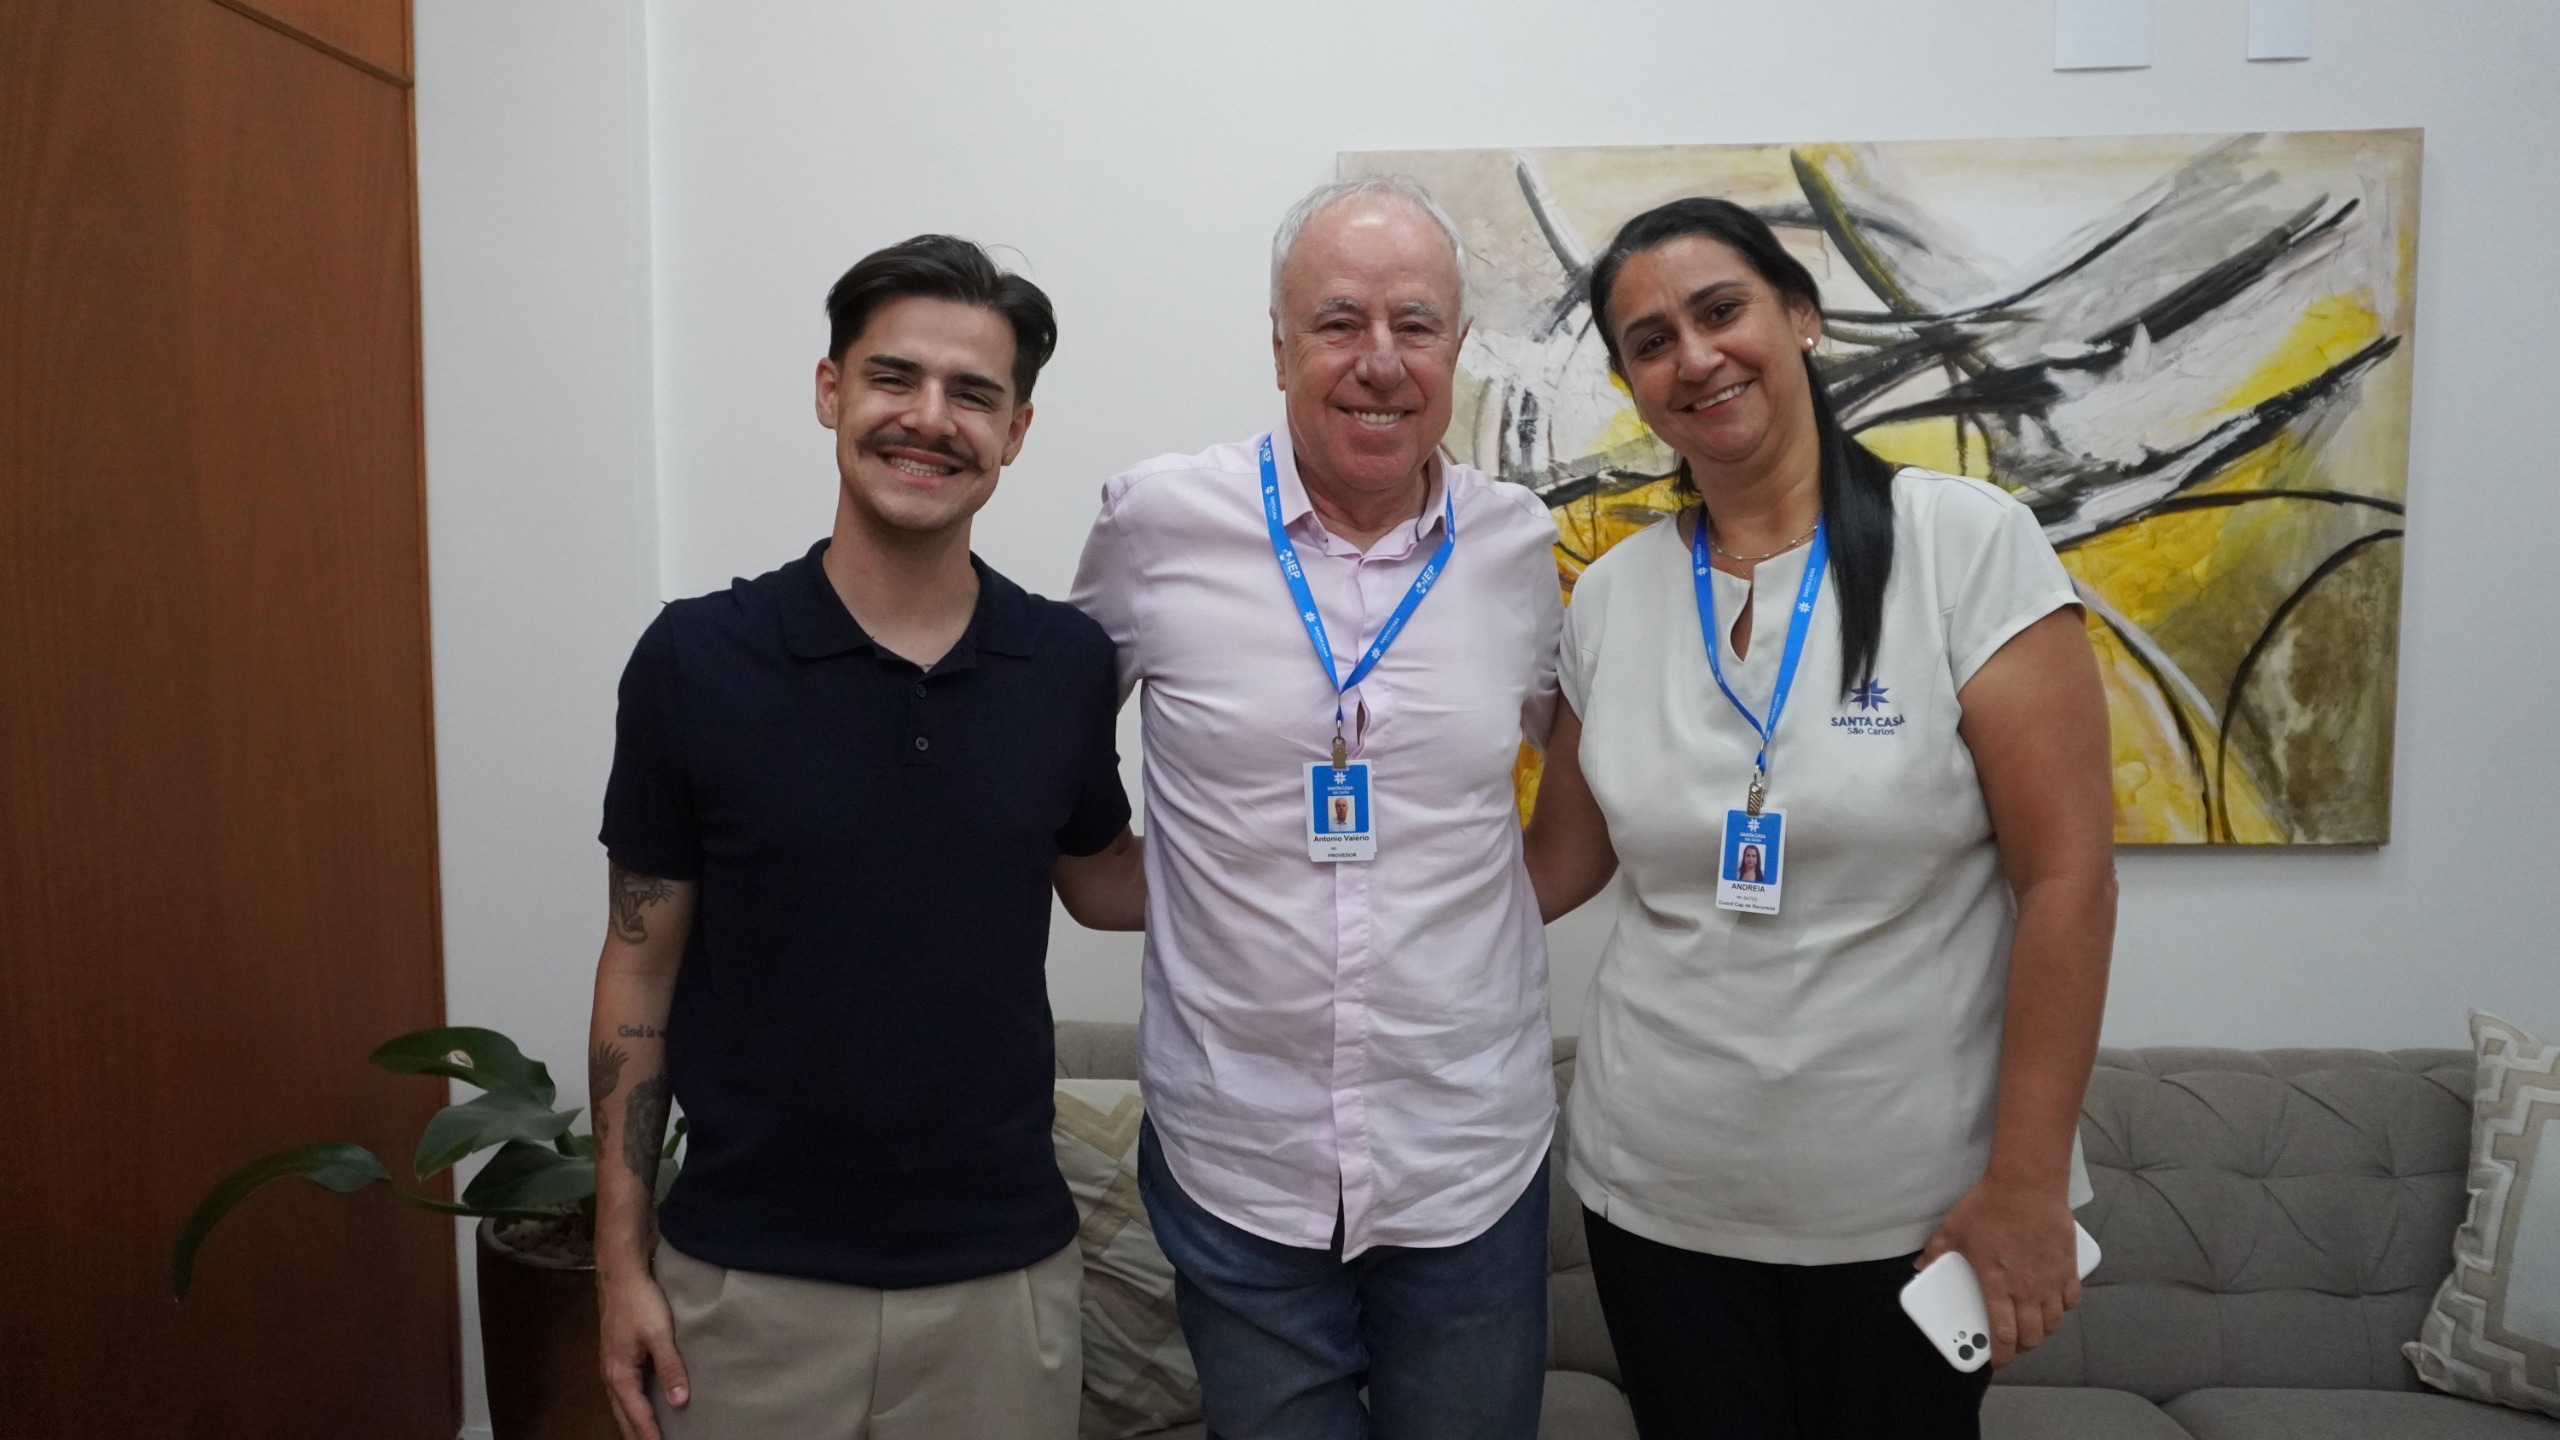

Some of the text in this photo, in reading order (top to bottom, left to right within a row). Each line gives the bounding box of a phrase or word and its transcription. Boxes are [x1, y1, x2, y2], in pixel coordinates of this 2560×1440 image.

[1286, 560, 1301, 580] IEP
[1423, 564, 1435, 584] IEP
[1380, 617, 1400, 645] SANTA CASA
[1831, 713, 1906, 727] SANTA CASA
[1847, 727, 1895, 736] São Carlos
[1731, 883, 1765, 892] ANDREIA
[618, 1024, 644, 1038] God
[646, 1026, 656, 1039] is
